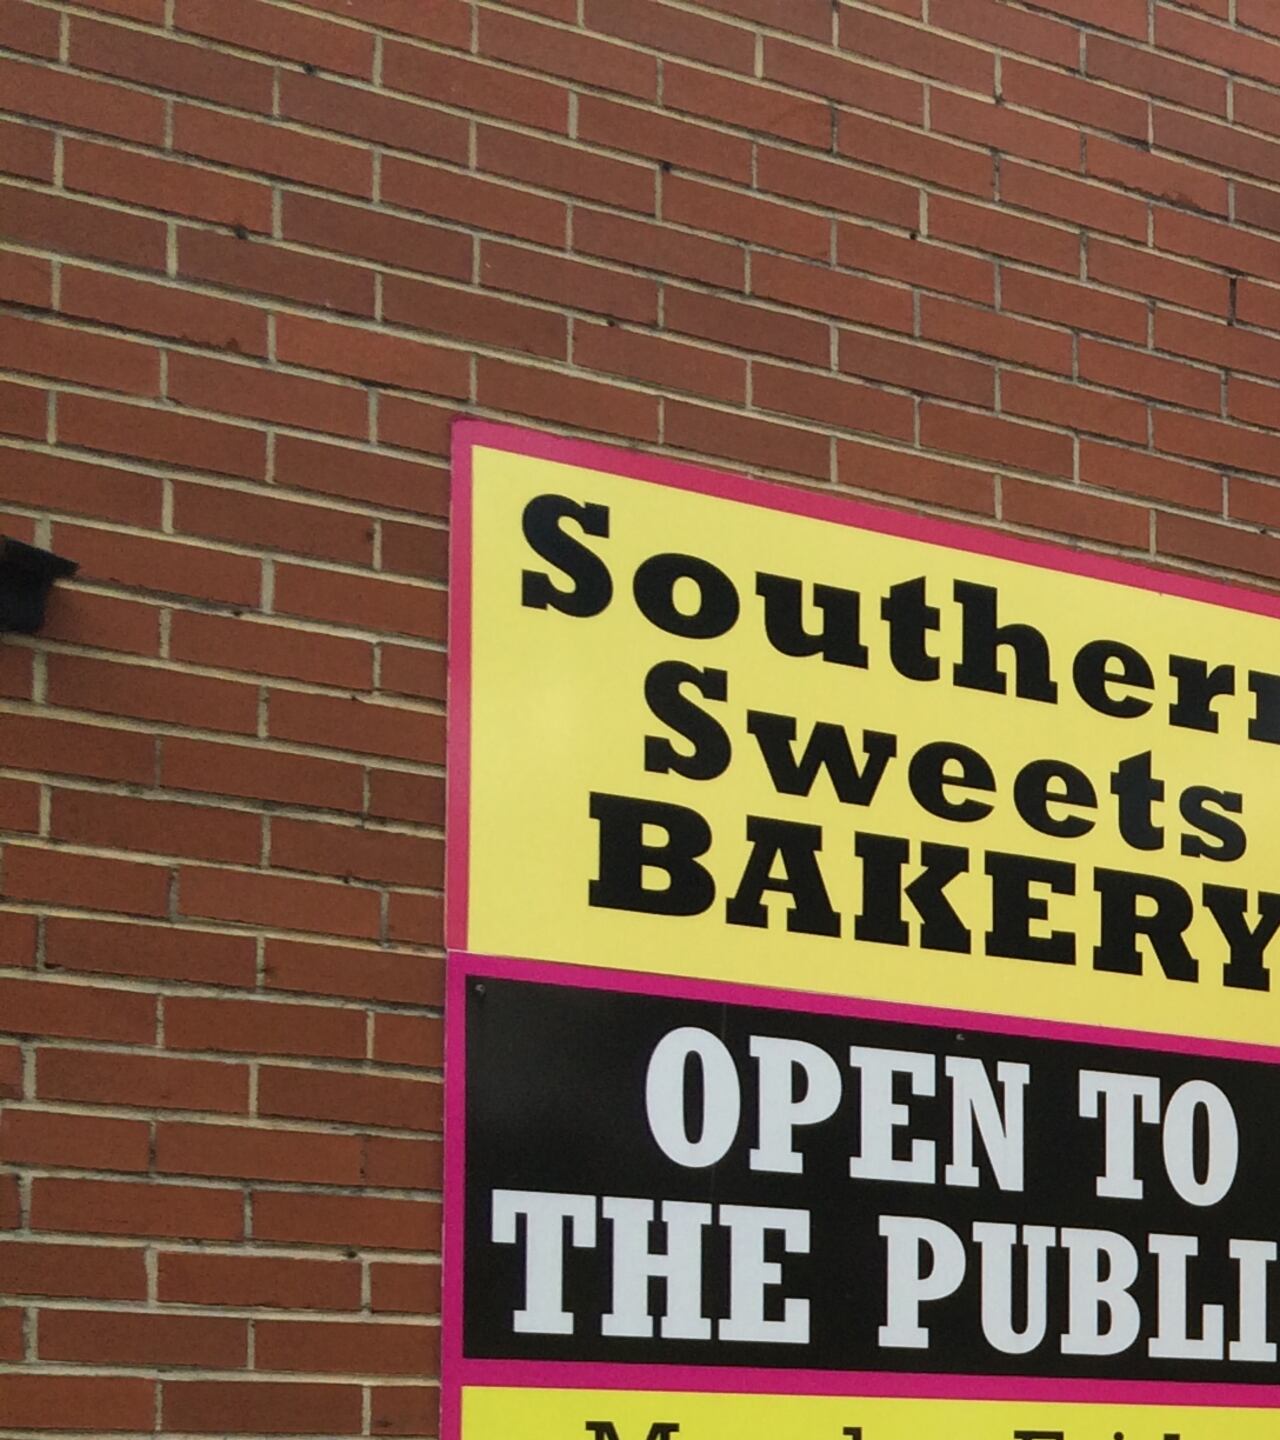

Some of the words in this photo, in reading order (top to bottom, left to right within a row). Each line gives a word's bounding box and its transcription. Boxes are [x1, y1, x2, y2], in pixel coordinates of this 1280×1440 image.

[643, 659, 1247, 862] Sweets
[645, 1026, 1030, 1192] OPEN
[1078, 1069, 1239, 1207] TO
[491, 1189, 811, 1345] THE
